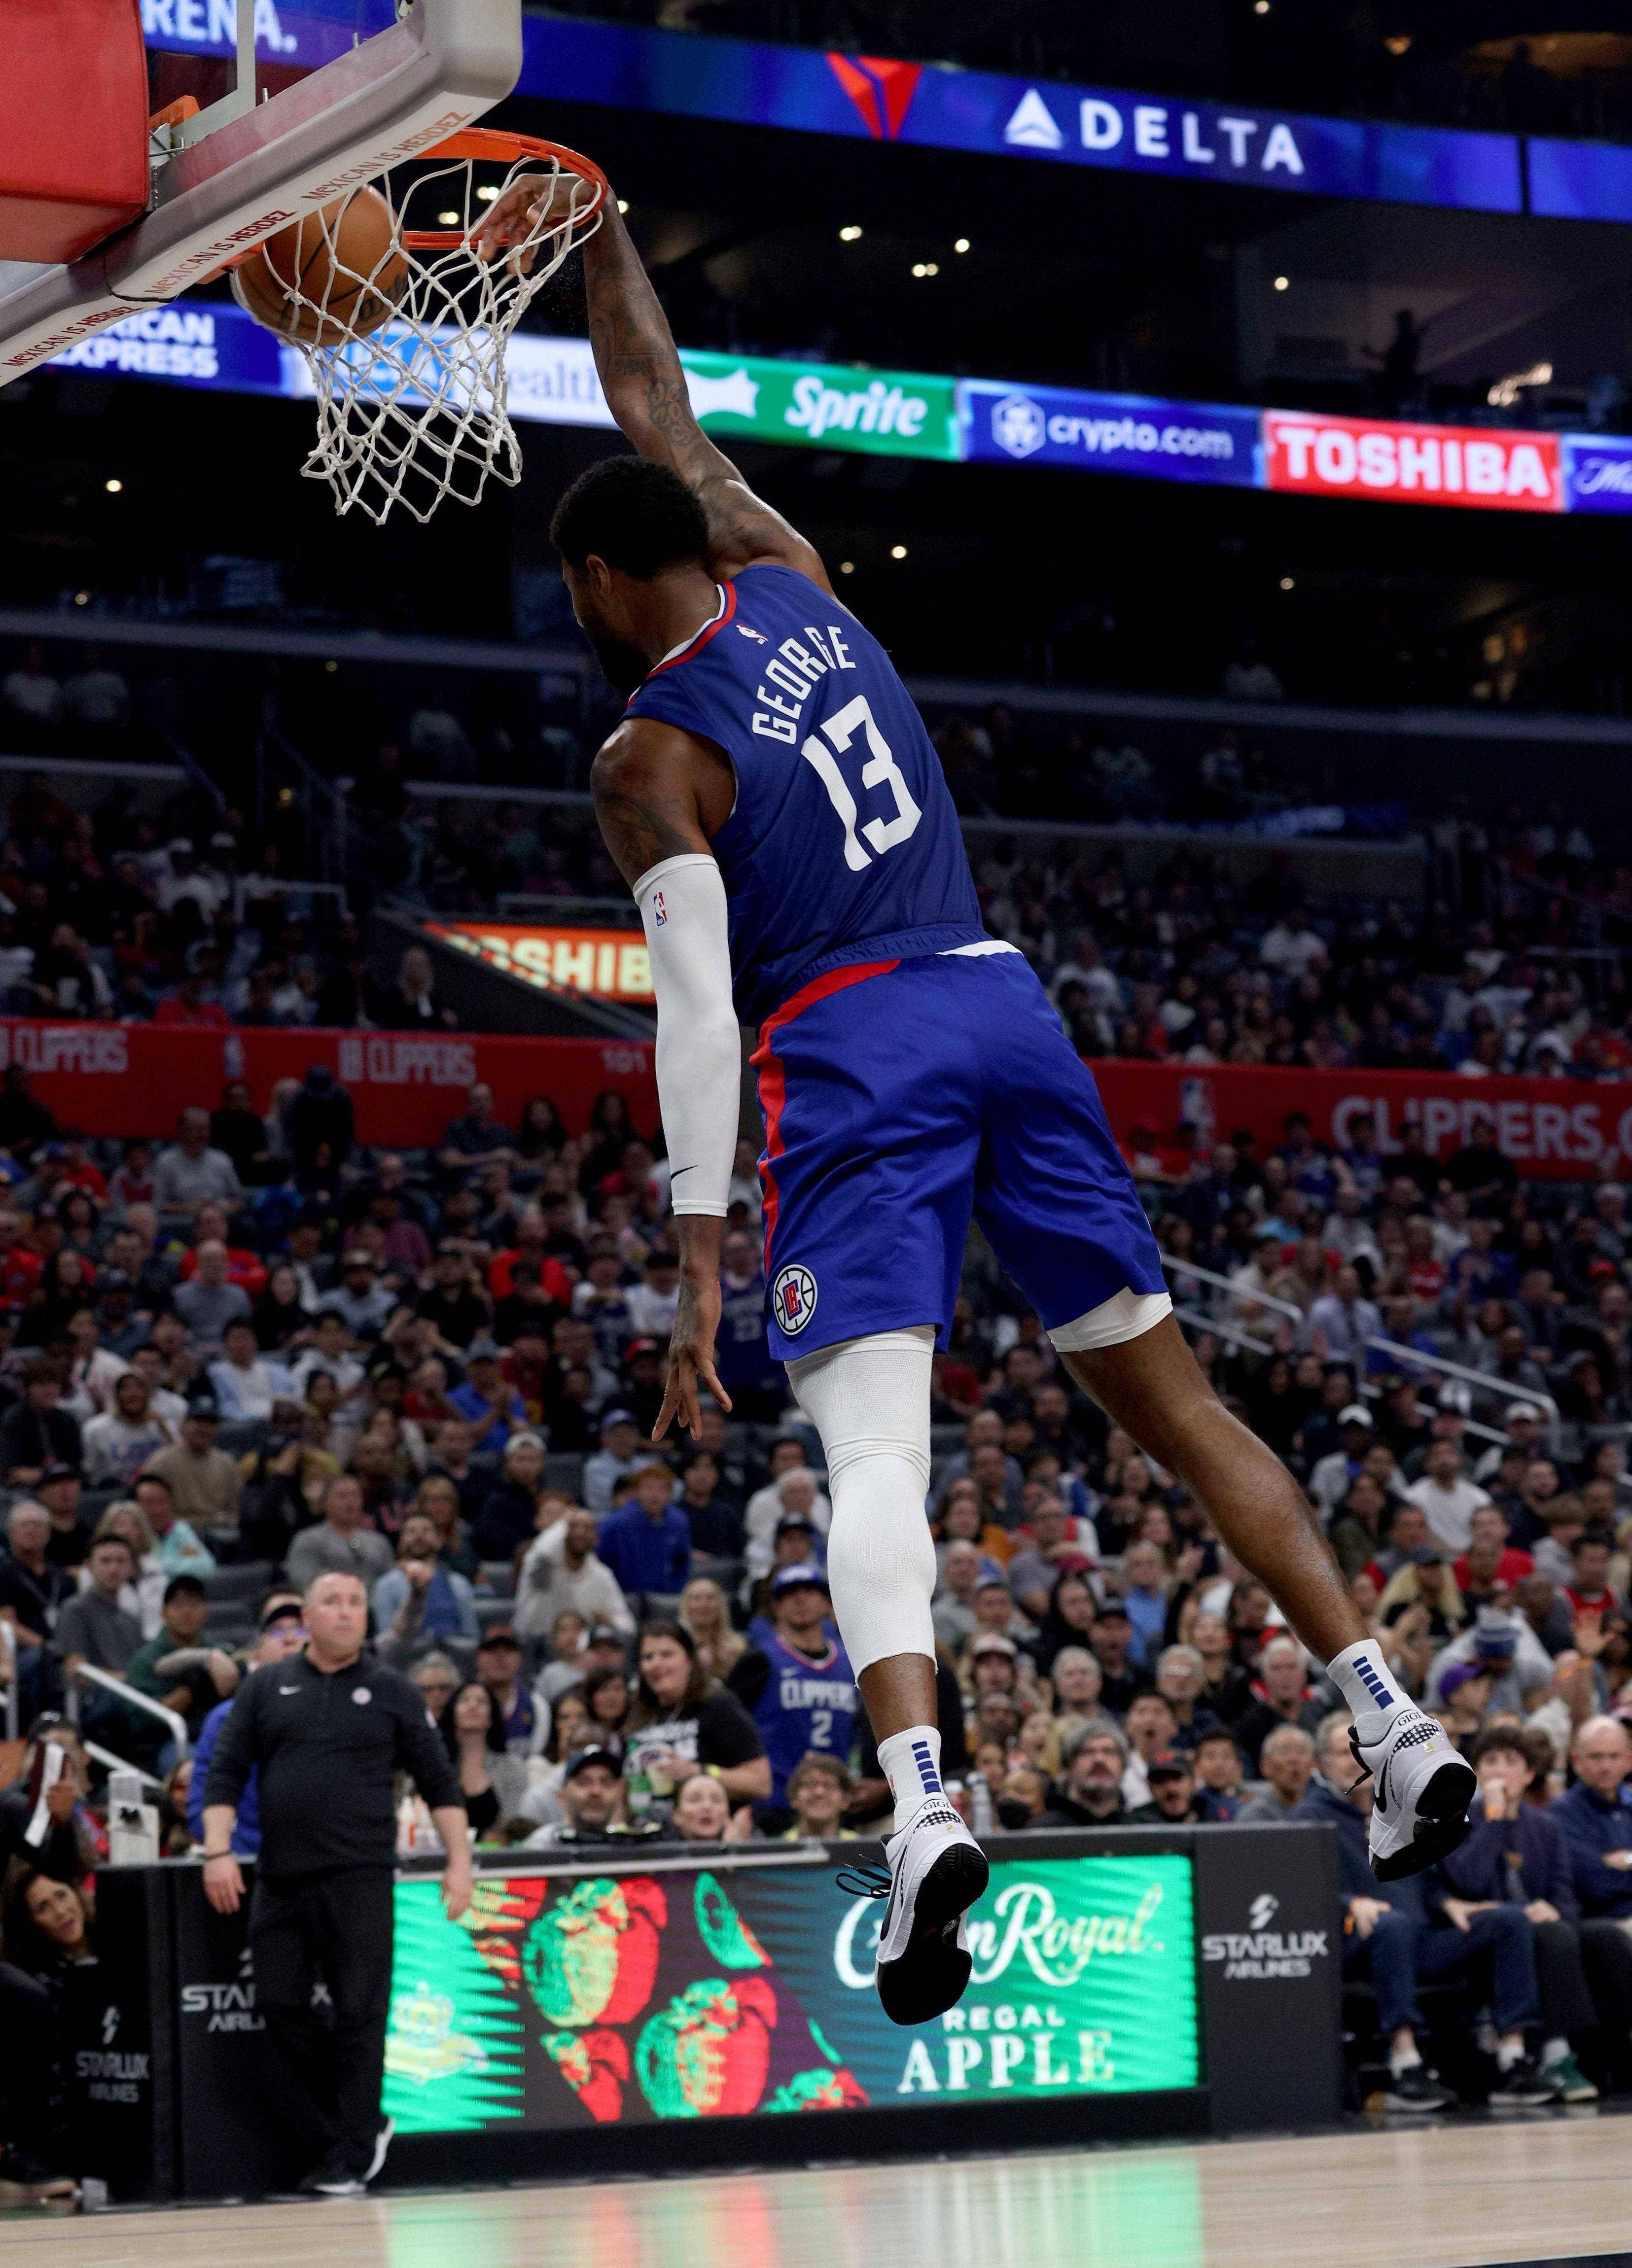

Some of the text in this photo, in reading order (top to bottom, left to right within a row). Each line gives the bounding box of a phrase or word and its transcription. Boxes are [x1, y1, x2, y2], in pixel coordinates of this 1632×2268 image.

[141, 0, 297, 52] RENA.
[374, 152, 401, 161] IS
[393, 111, 474, 152] HERDEZ
[1080, 99, 1305, 175] DELTA
[208, 243, 235, 251] IS
[225, 210, 298, 242] HERDEZ
[75, 306, 144, 326] HERDEZ
[784, 376, 928, 438] Sprite
[1048, 415, 1234, 459] crypto.com
[1277, 427, 1552, 498] TOSHIBA
[752, 626, 856, 745] GEORGE
[800, 695, 922, 872] 13
[810, 1709, 833, 1748] 2
[1398, 1712, 1421, 1726] GIGI
[923, 1801, 950, 1810] GIGI
[1202, 1931, 1329, 1961] STARLUX
[1224, 1958, 1312, 1980] AIRLINES
[942, 2004, 1066, 2031] REGAL
[897, 2029, 1114, 2094] APPLE
